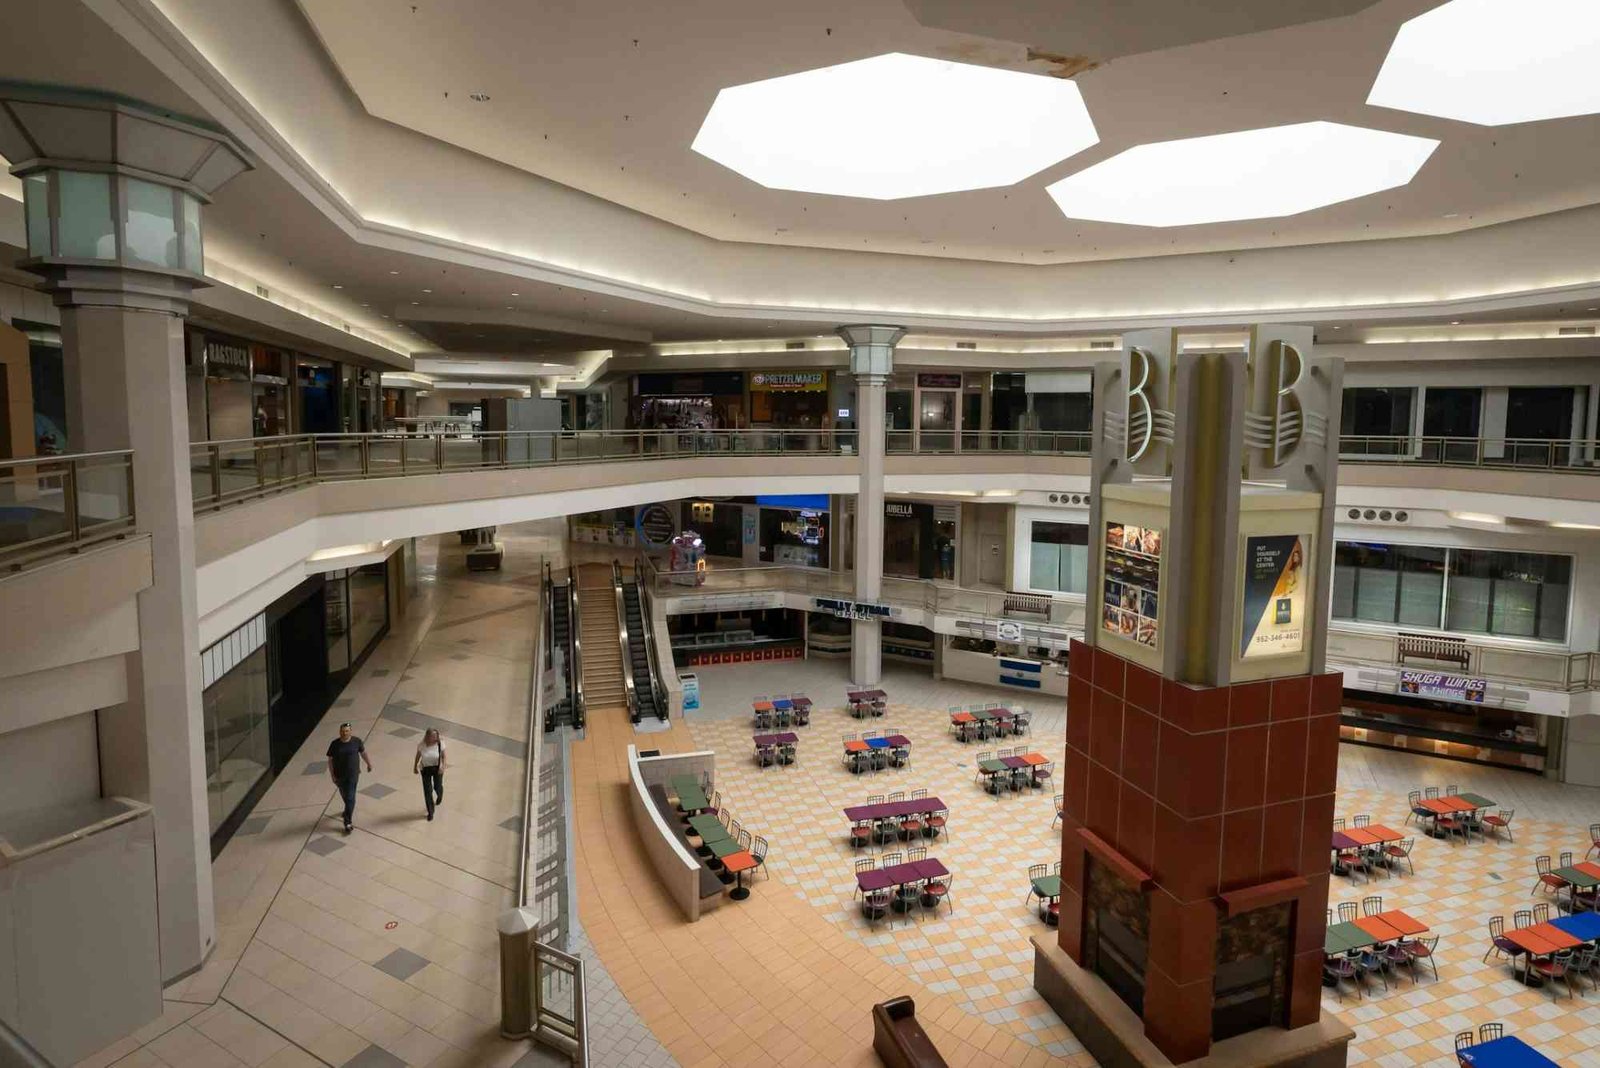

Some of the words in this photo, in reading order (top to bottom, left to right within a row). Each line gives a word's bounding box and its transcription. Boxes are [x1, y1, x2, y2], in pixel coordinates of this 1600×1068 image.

[208, 343, 248, 366] RAGSTOCK
[765, 373, 821, 384] PRETZELMAKER
[1401, 672, 1442, 685] SHUGA
[1445, 677, 1486, 690] WINGS
[1431, 687, 1465, 697] THINGS
